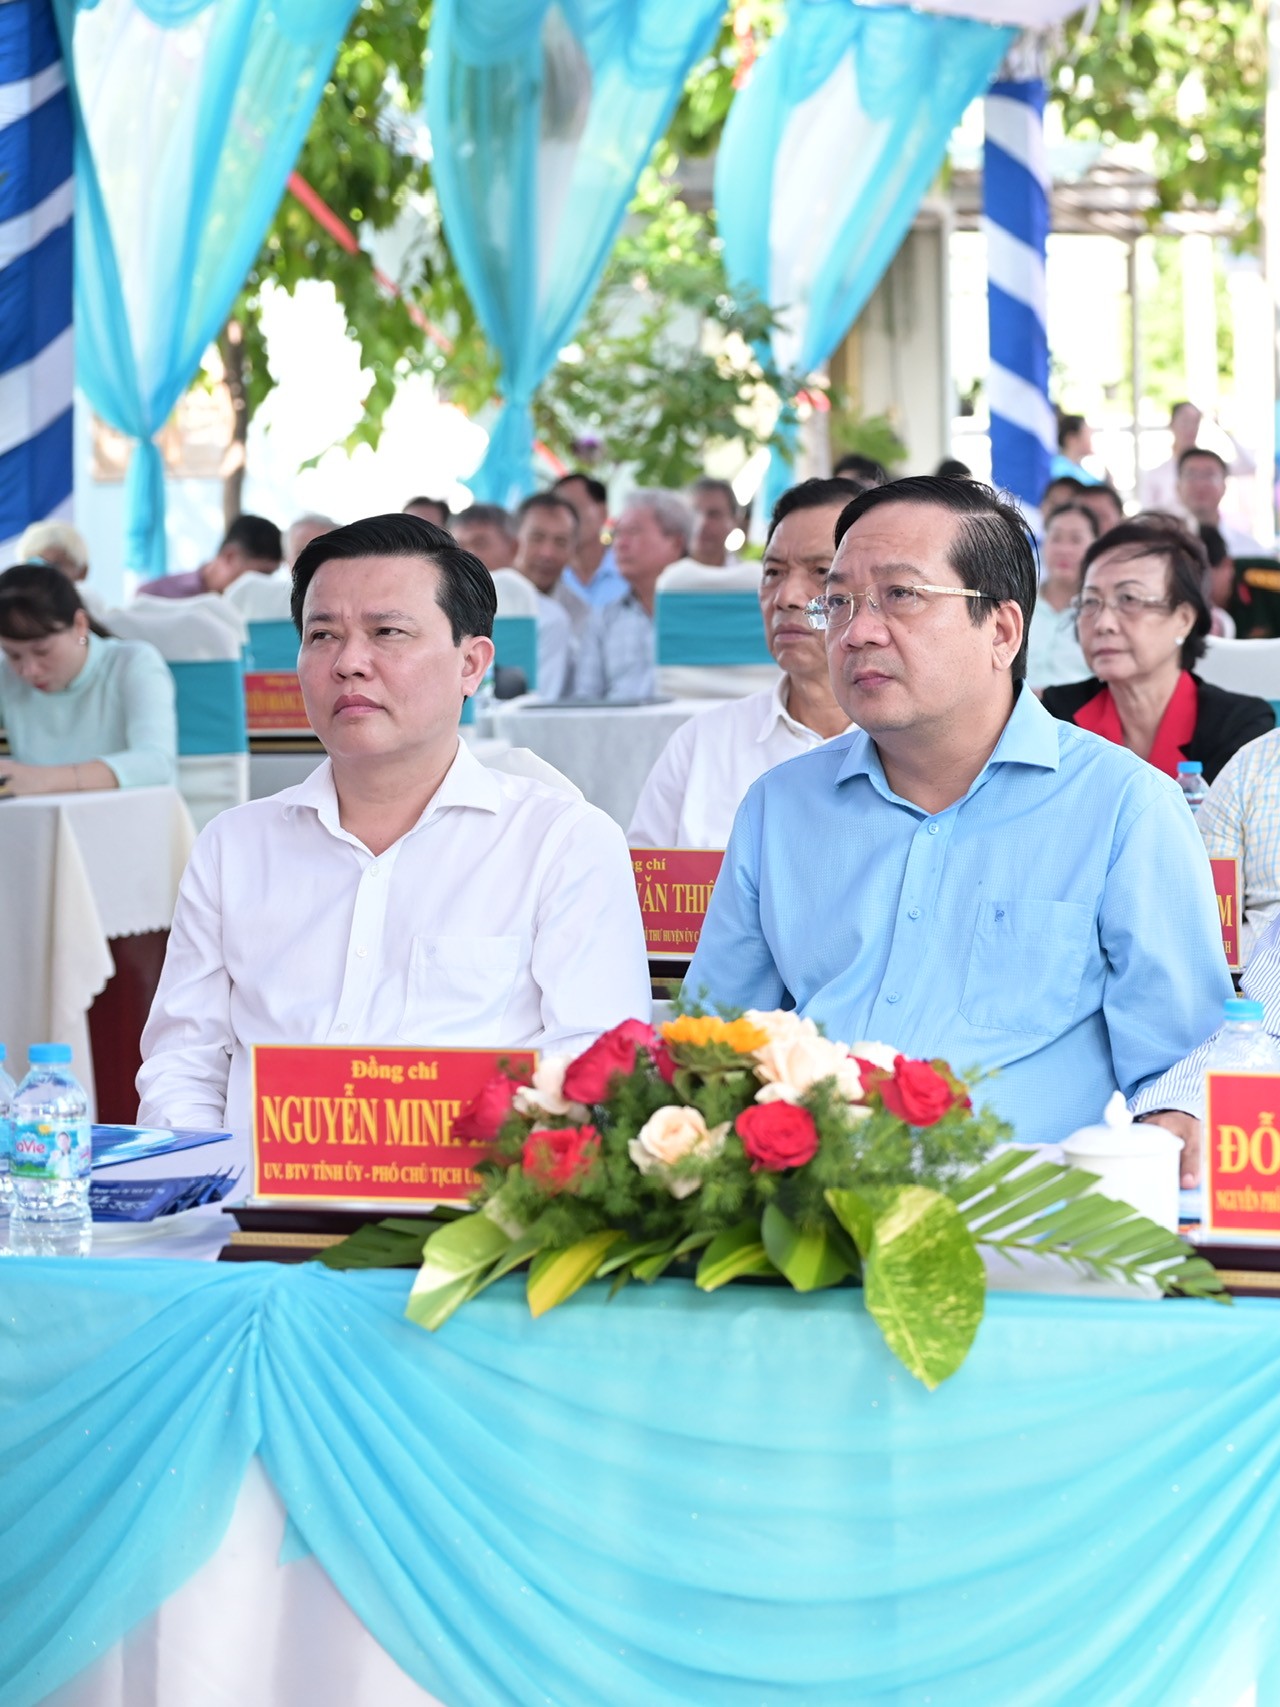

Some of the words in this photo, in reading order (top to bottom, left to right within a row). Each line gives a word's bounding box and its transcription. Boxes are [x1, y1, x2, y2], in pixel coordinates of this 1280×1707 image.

[646, 858, 666, 870] chí
[351, 1056, 404, 1084] Đồng
[408, 1061, 438, 1080] chí
[262, 1083, 379, 1146] NGUYỄN
